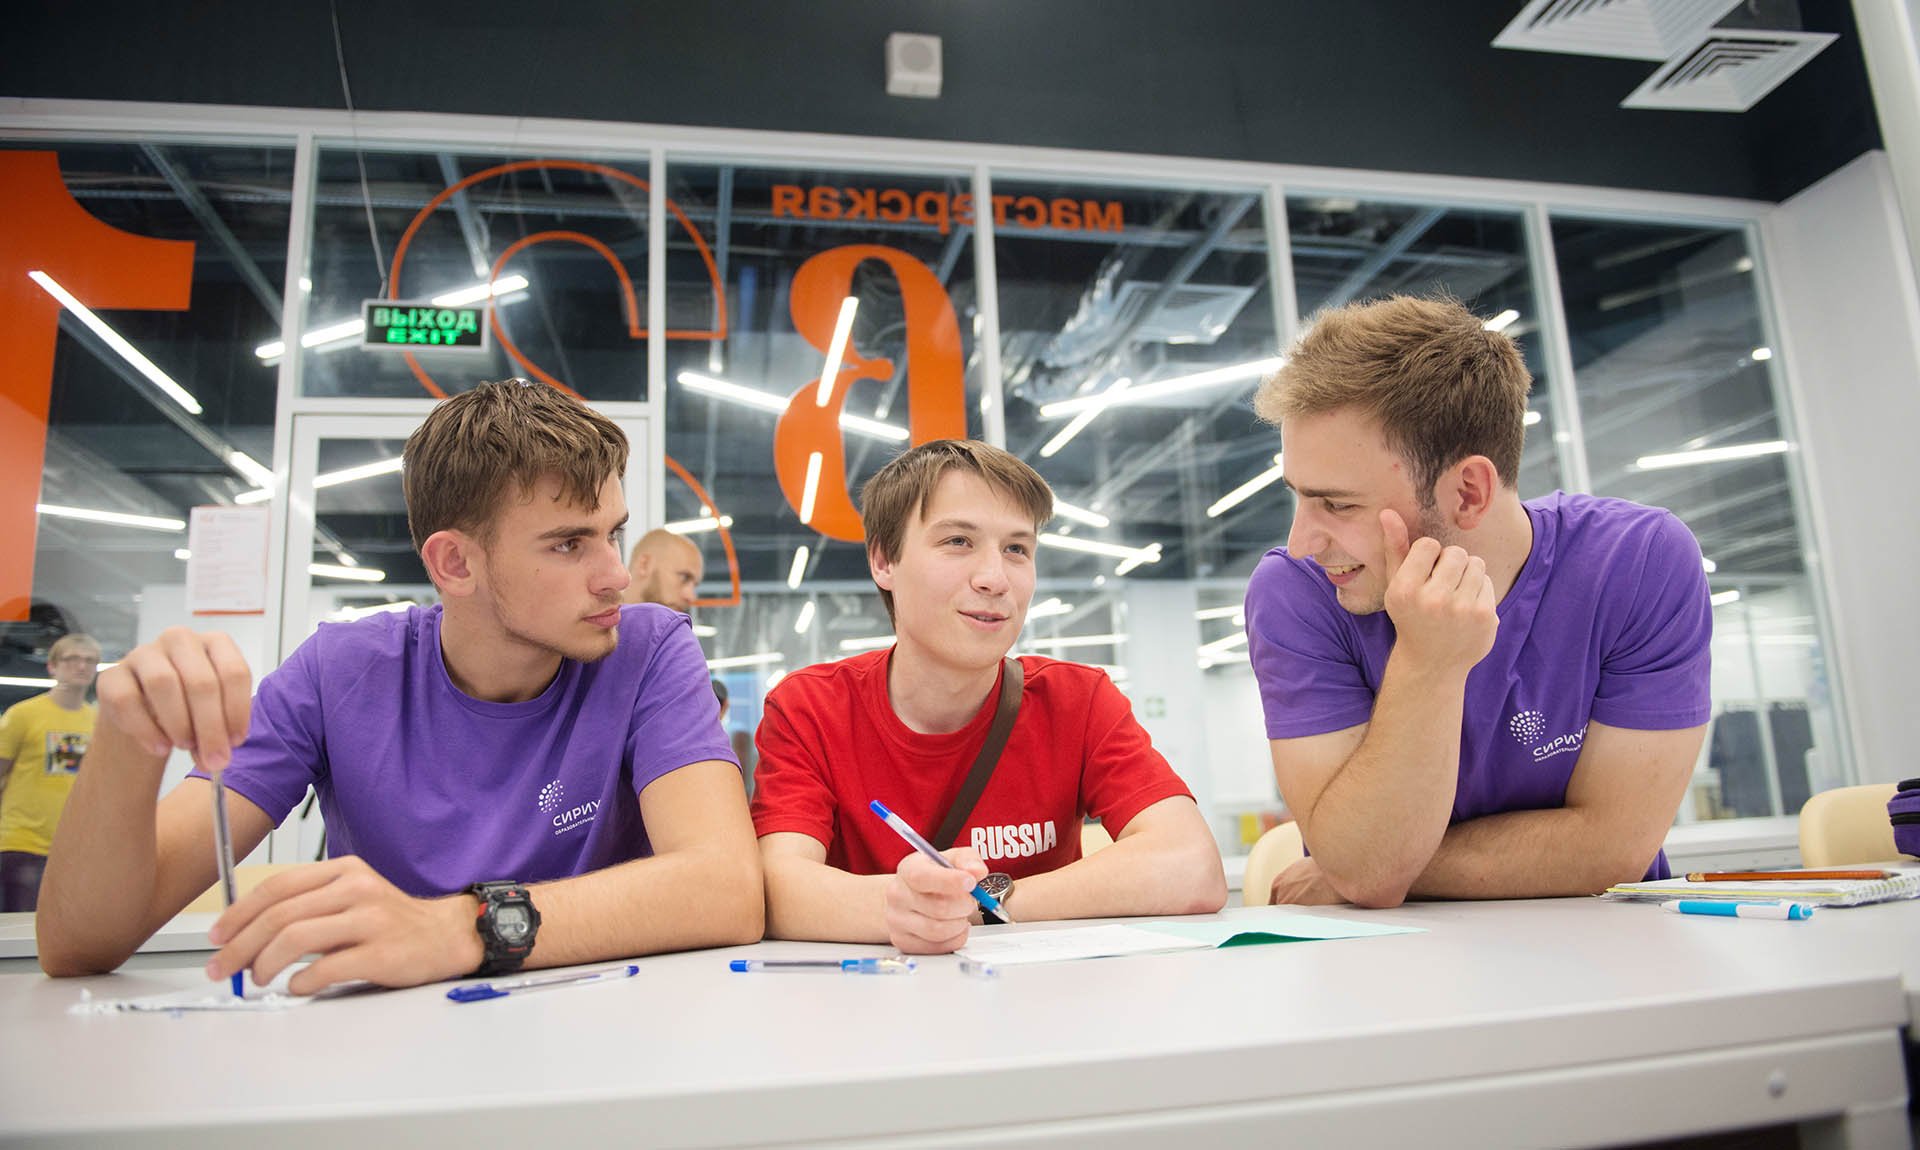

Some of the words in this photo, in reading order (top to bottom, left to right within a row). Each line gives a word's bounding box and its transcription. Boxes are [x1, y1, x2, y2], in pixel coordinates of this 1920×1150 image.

[373, 307, 477, 334] ВЫХОД
[386, 327, 462, 345] EXIT
[971, 820, 1057, 860] RUSSIA
